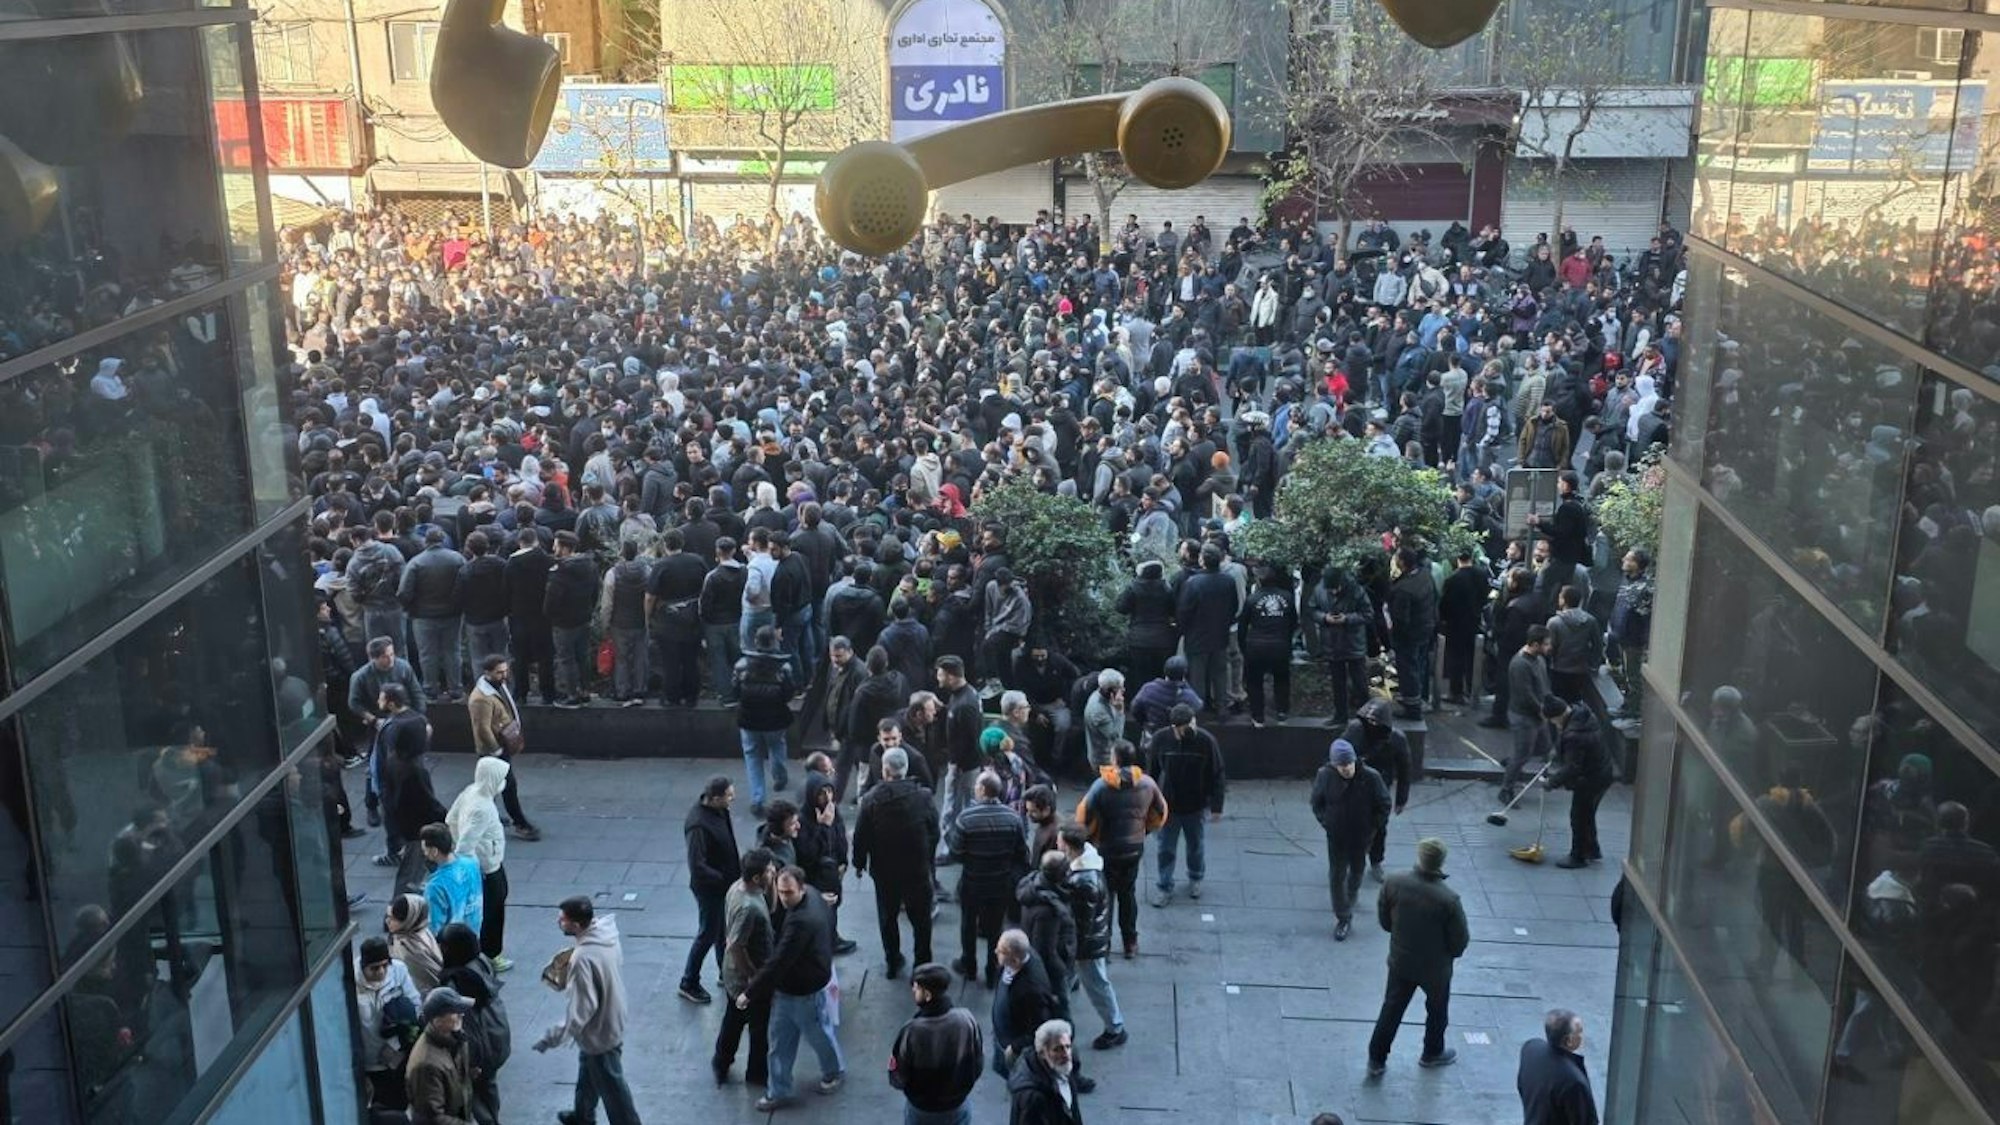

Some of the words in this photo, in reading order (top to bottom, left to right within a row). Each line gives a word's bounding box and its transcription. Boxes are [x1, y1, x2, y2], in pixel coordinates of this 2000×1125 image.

[897, 33, 926, 48] اداری
[927, 32, 959, 47] تجاری
[960, 33, 995, 47] مجتمع
[905, 75, 989, 115] نادری
